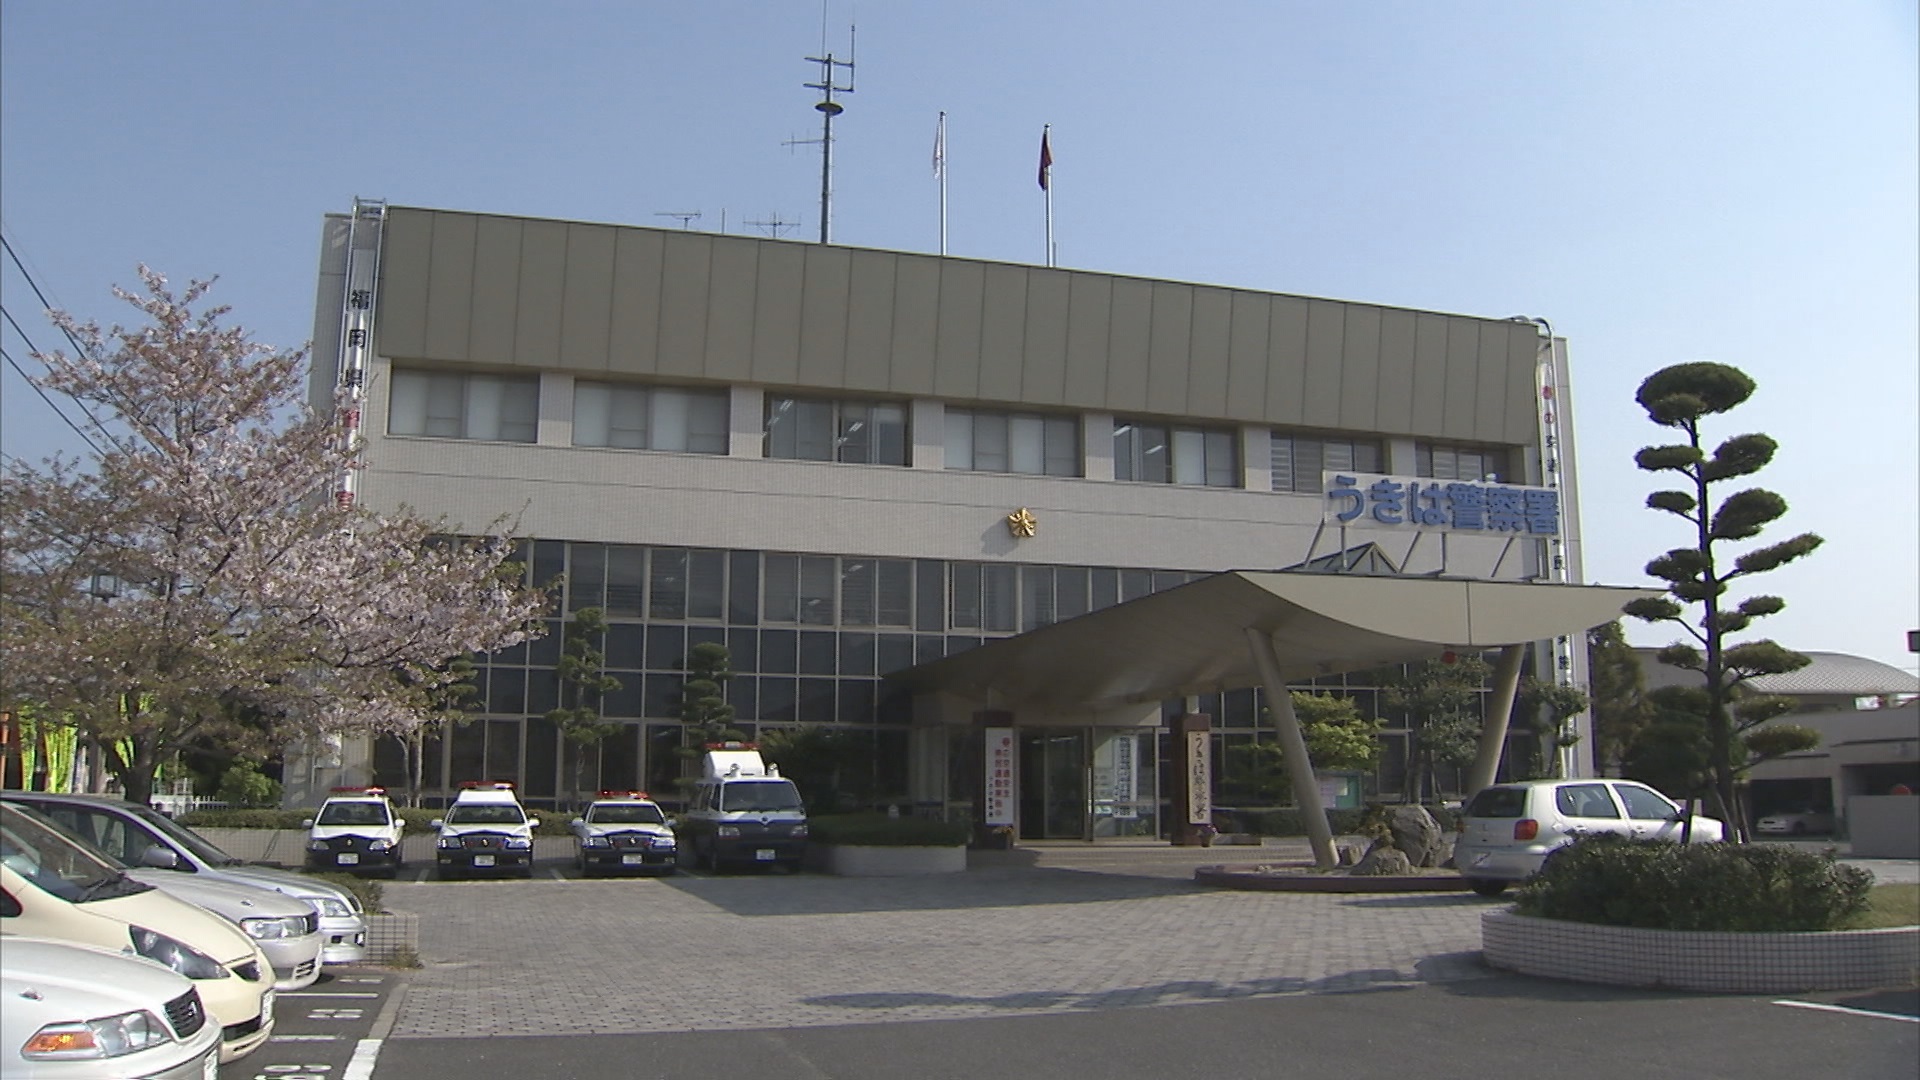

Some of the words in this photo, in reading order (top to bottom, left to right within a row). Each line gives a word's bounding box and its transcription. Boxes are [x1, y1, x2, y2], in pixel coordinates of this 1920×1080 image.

[1328, 474, 1560, 536] うきは警察署
